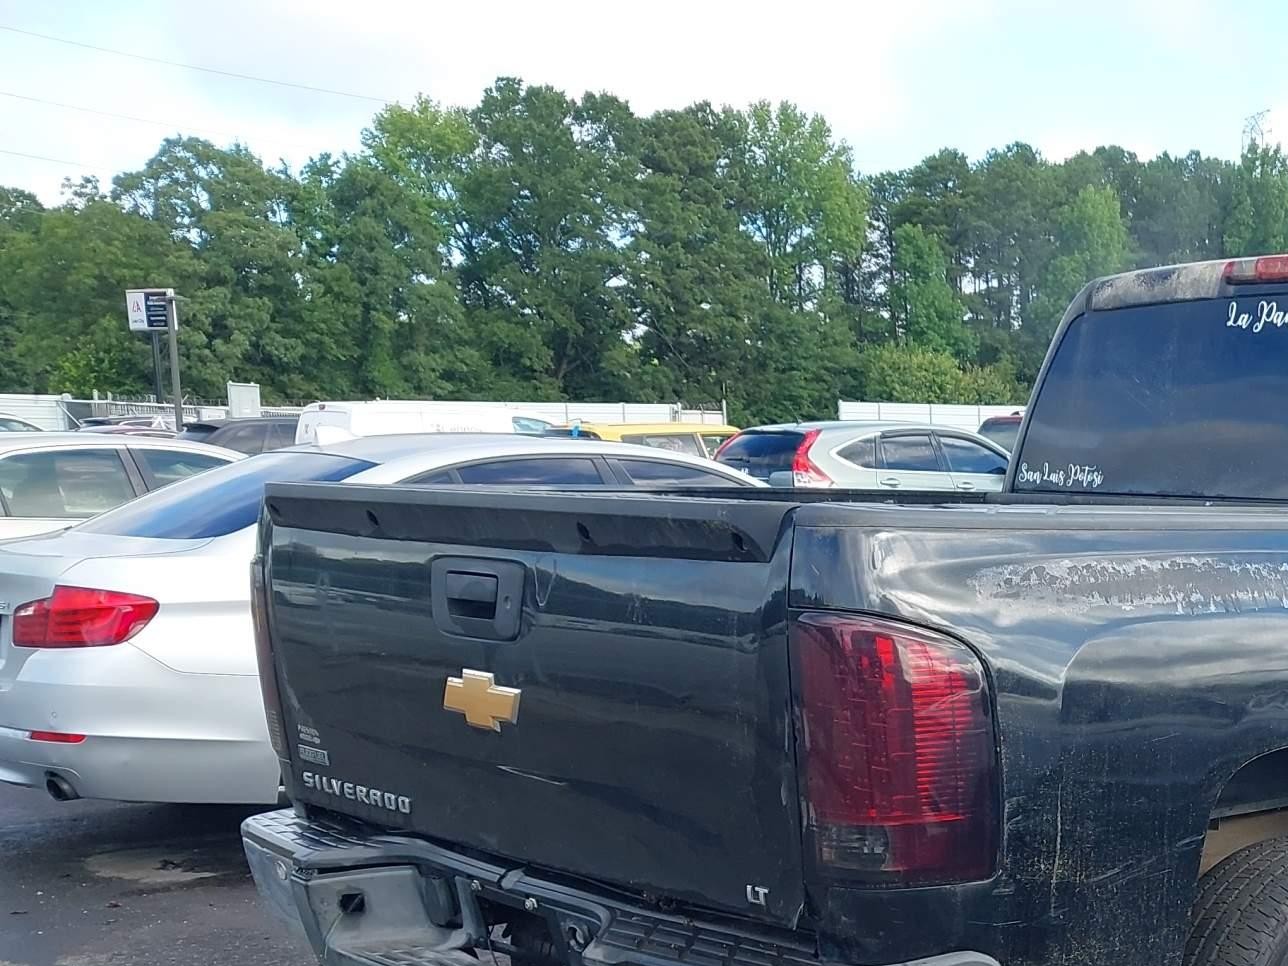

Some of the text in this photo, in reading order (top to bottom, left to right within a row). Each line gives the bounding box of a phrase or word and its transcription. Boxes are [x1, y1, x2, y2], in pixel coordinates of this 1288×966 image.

[1226, 301, 1253, 329] La
[1018, 462, 1041, 485] San
[302, 771, 412, 815] SILVERADO
[746, 884, 769, 906] LT
